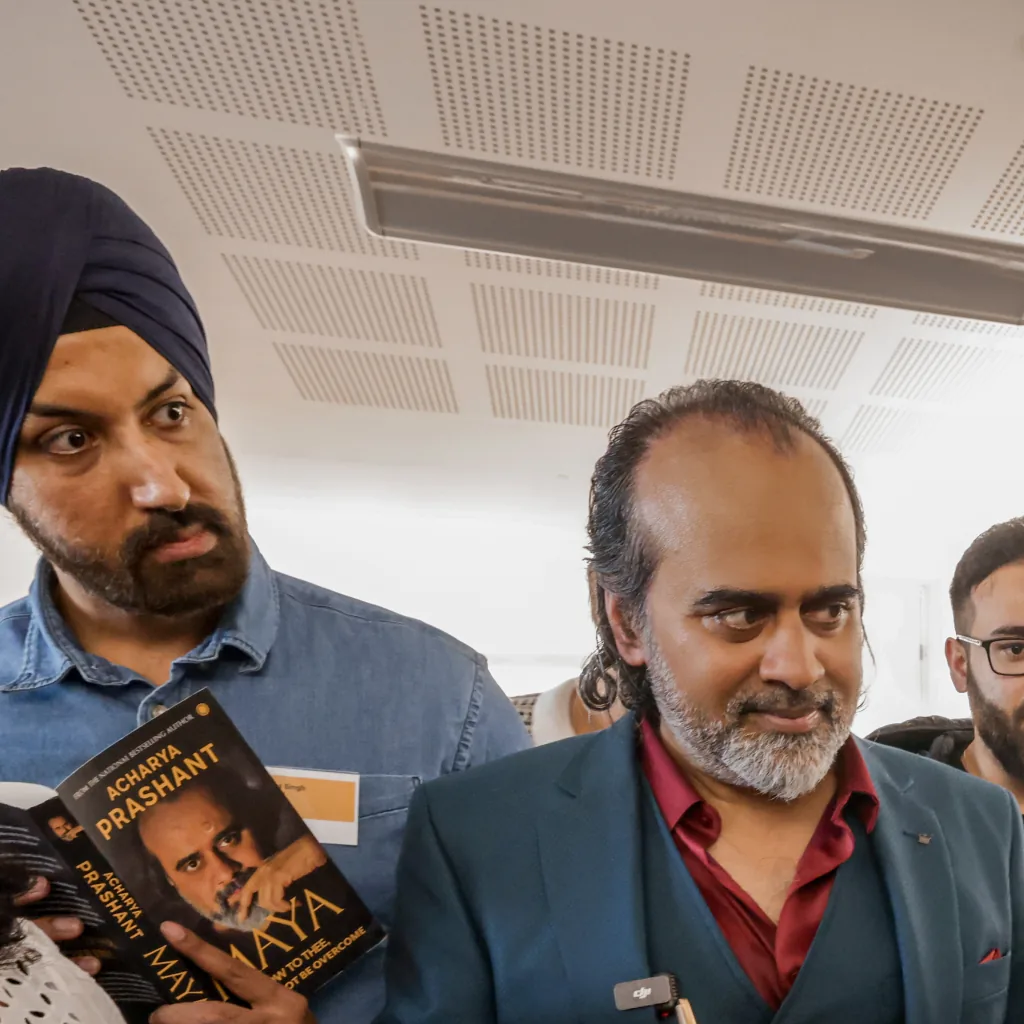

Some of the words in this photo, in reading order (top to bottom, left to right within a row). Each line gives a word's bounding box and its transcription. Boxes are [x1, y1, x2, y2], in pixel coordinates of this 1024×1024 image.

[98, 754, 130, 779] NATIONAL
[128, 730, 167, 759] BESTSELLING
[166, 713, 196, 734] AUTHOR
[106, 744, 182, 801] ACHARYA
[96, 743, 219, 841] PRASHANT
[76, 860, 144, 940] PRASHANT
[102, 872, 143, 919] ACHARYA
[143, 945, 207, 1001] MAY
[285, 957, 303, 972] TO
[301, 937, 332, 960] THEE,
[299, 966, 314, 980] BE
[312, 926, 367, 969] OVERCOME
